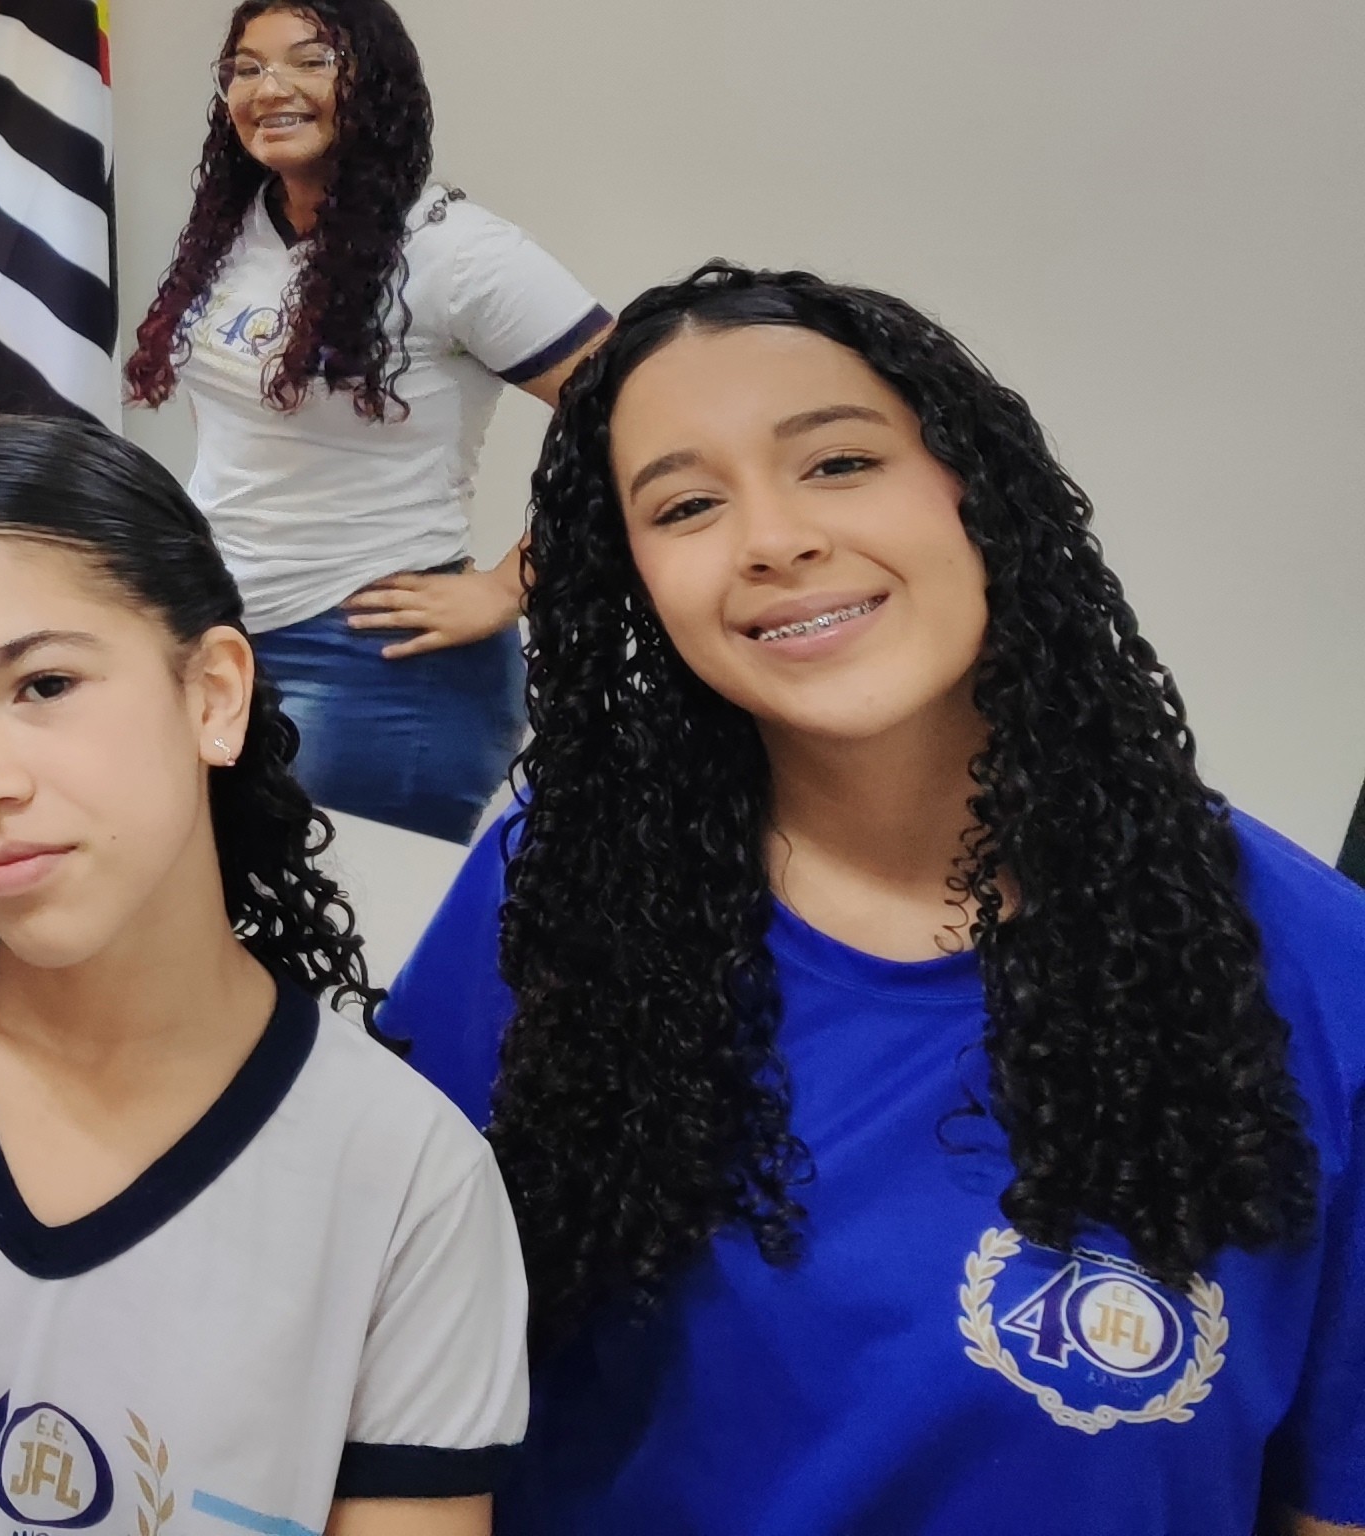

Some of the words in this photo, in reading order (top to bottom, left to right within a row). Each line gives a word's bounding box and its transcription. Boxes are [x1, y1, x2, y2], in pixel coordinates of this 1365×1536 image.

[215, 303, 284, 346] 40
[999, 1260, 1184, 1378] 40
[1088, 1301, 1152, 1356] JFL
[35, 1413, 69, 1444] E.E.
[10, 1440, 81, 1510] JFL
